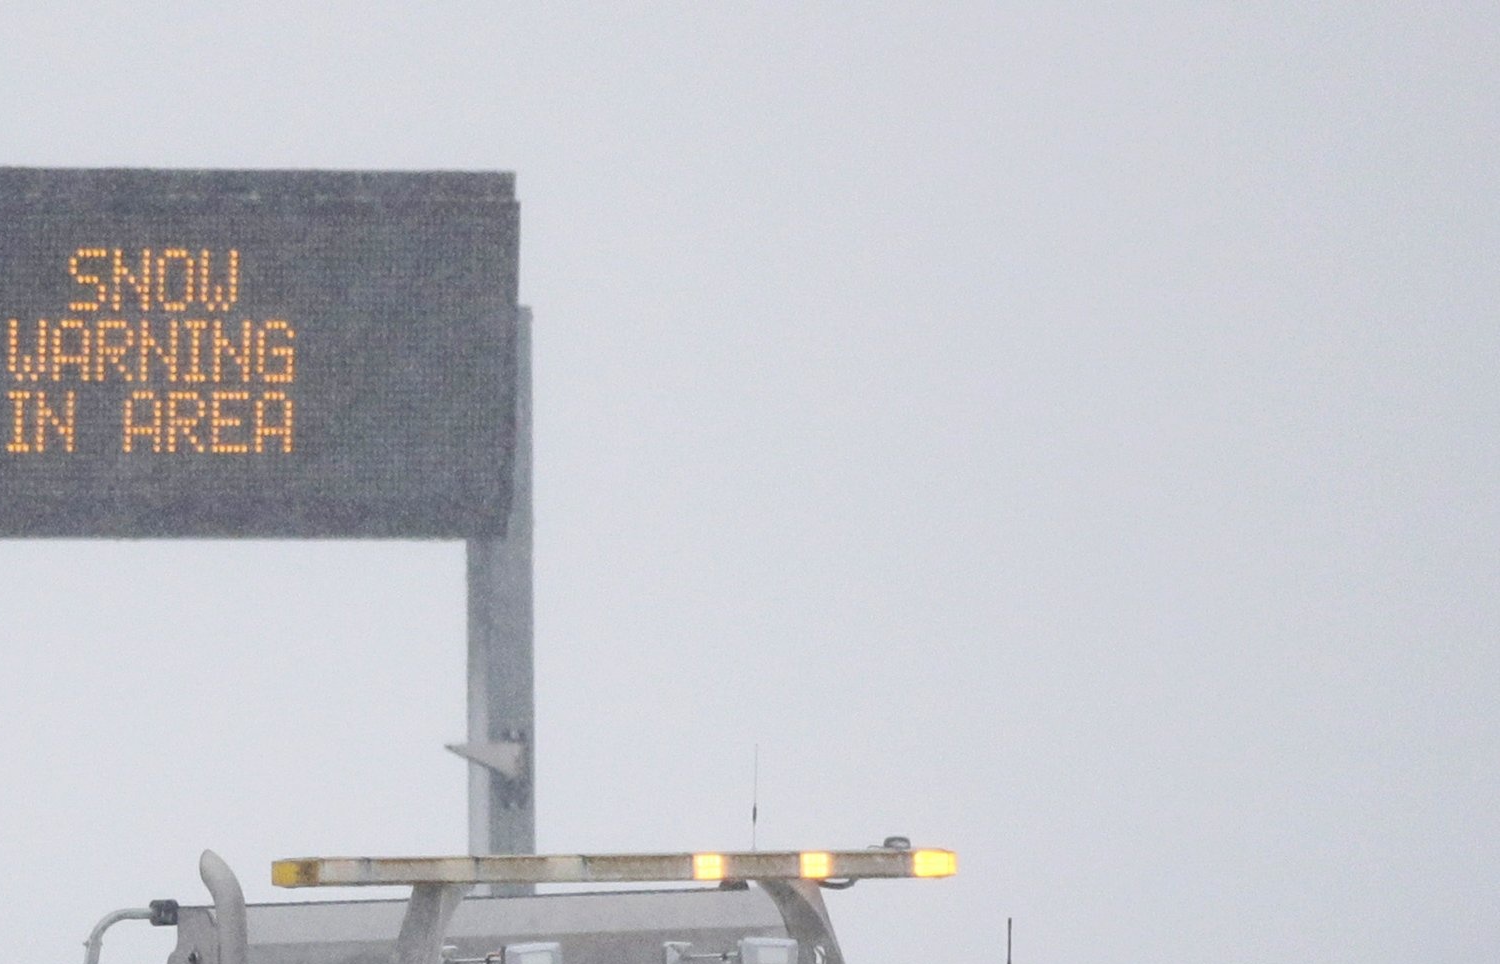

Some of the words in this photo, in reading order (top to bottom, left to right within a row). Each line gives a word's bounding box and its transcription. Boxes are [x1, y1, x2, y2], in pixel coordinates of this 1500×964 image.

[68, 248, 239, 312] SNOW
[7, 319, 296, 383] WARNING
[6, 390, 76, 453] IN
[122, 390, 294, 453] AREA
